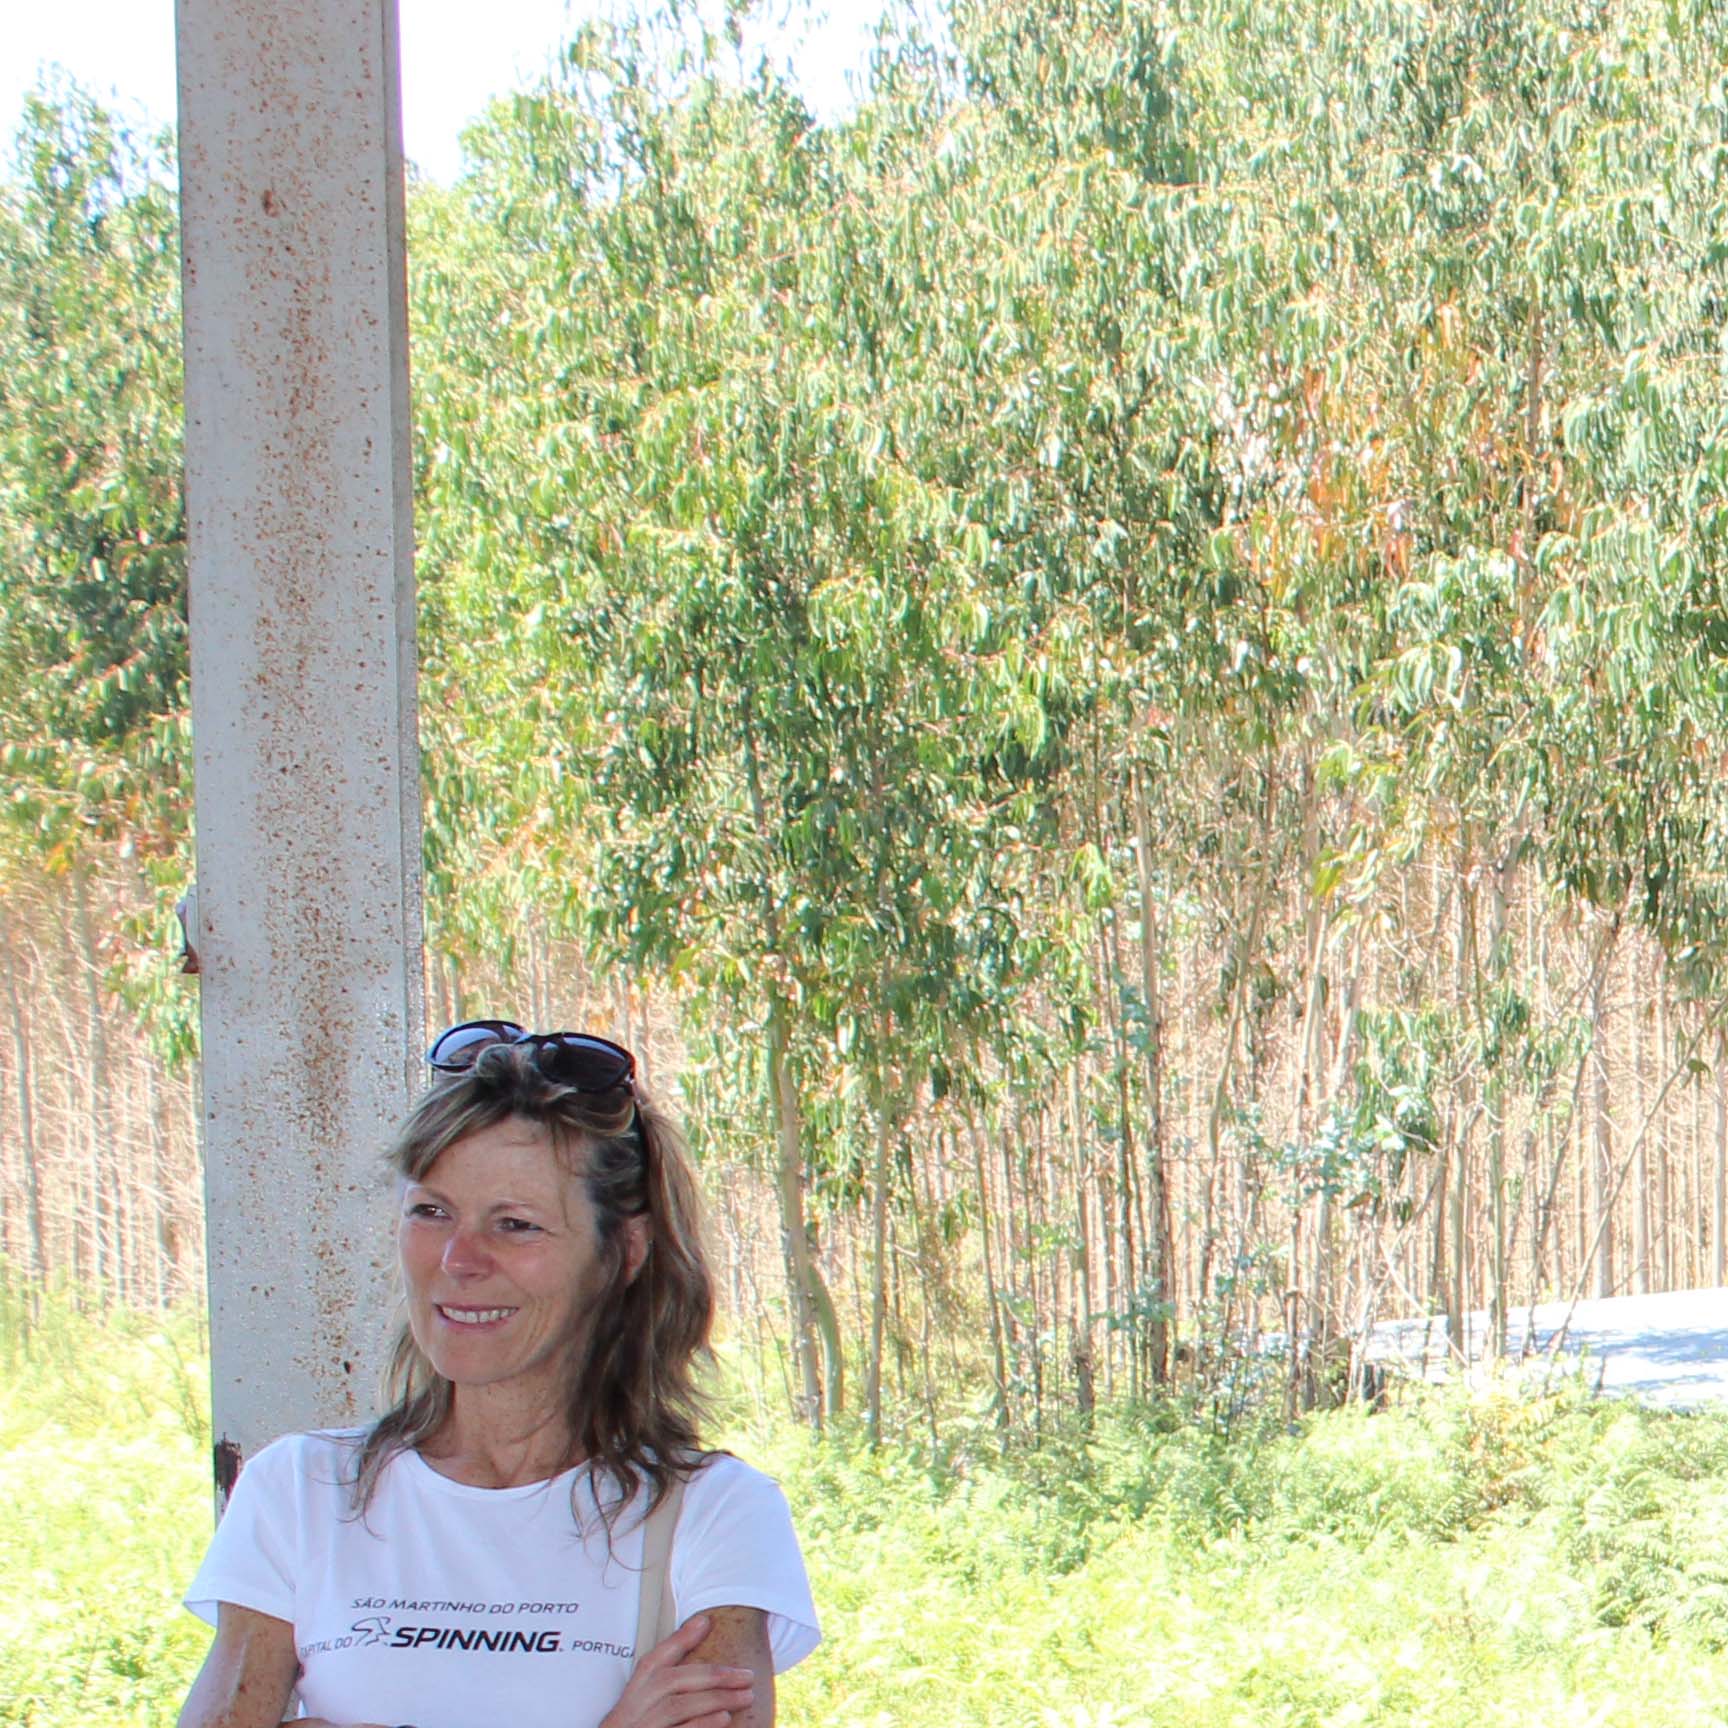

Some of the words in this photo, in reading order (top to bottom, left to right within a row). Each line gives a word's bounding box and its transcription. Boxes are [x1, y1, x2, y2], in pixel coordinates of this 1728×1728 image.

[351, 1596, 387, 1609] SÃO
[388, 1598, 486, 1613] MARTINHO
[488, 1602, 515, 1614] DO
[517, 1602, 580, 1614] PORTO
[390, 1626, 561, 1652] SPINNING
[571, 1639, 635, 1659] PORTUGA
